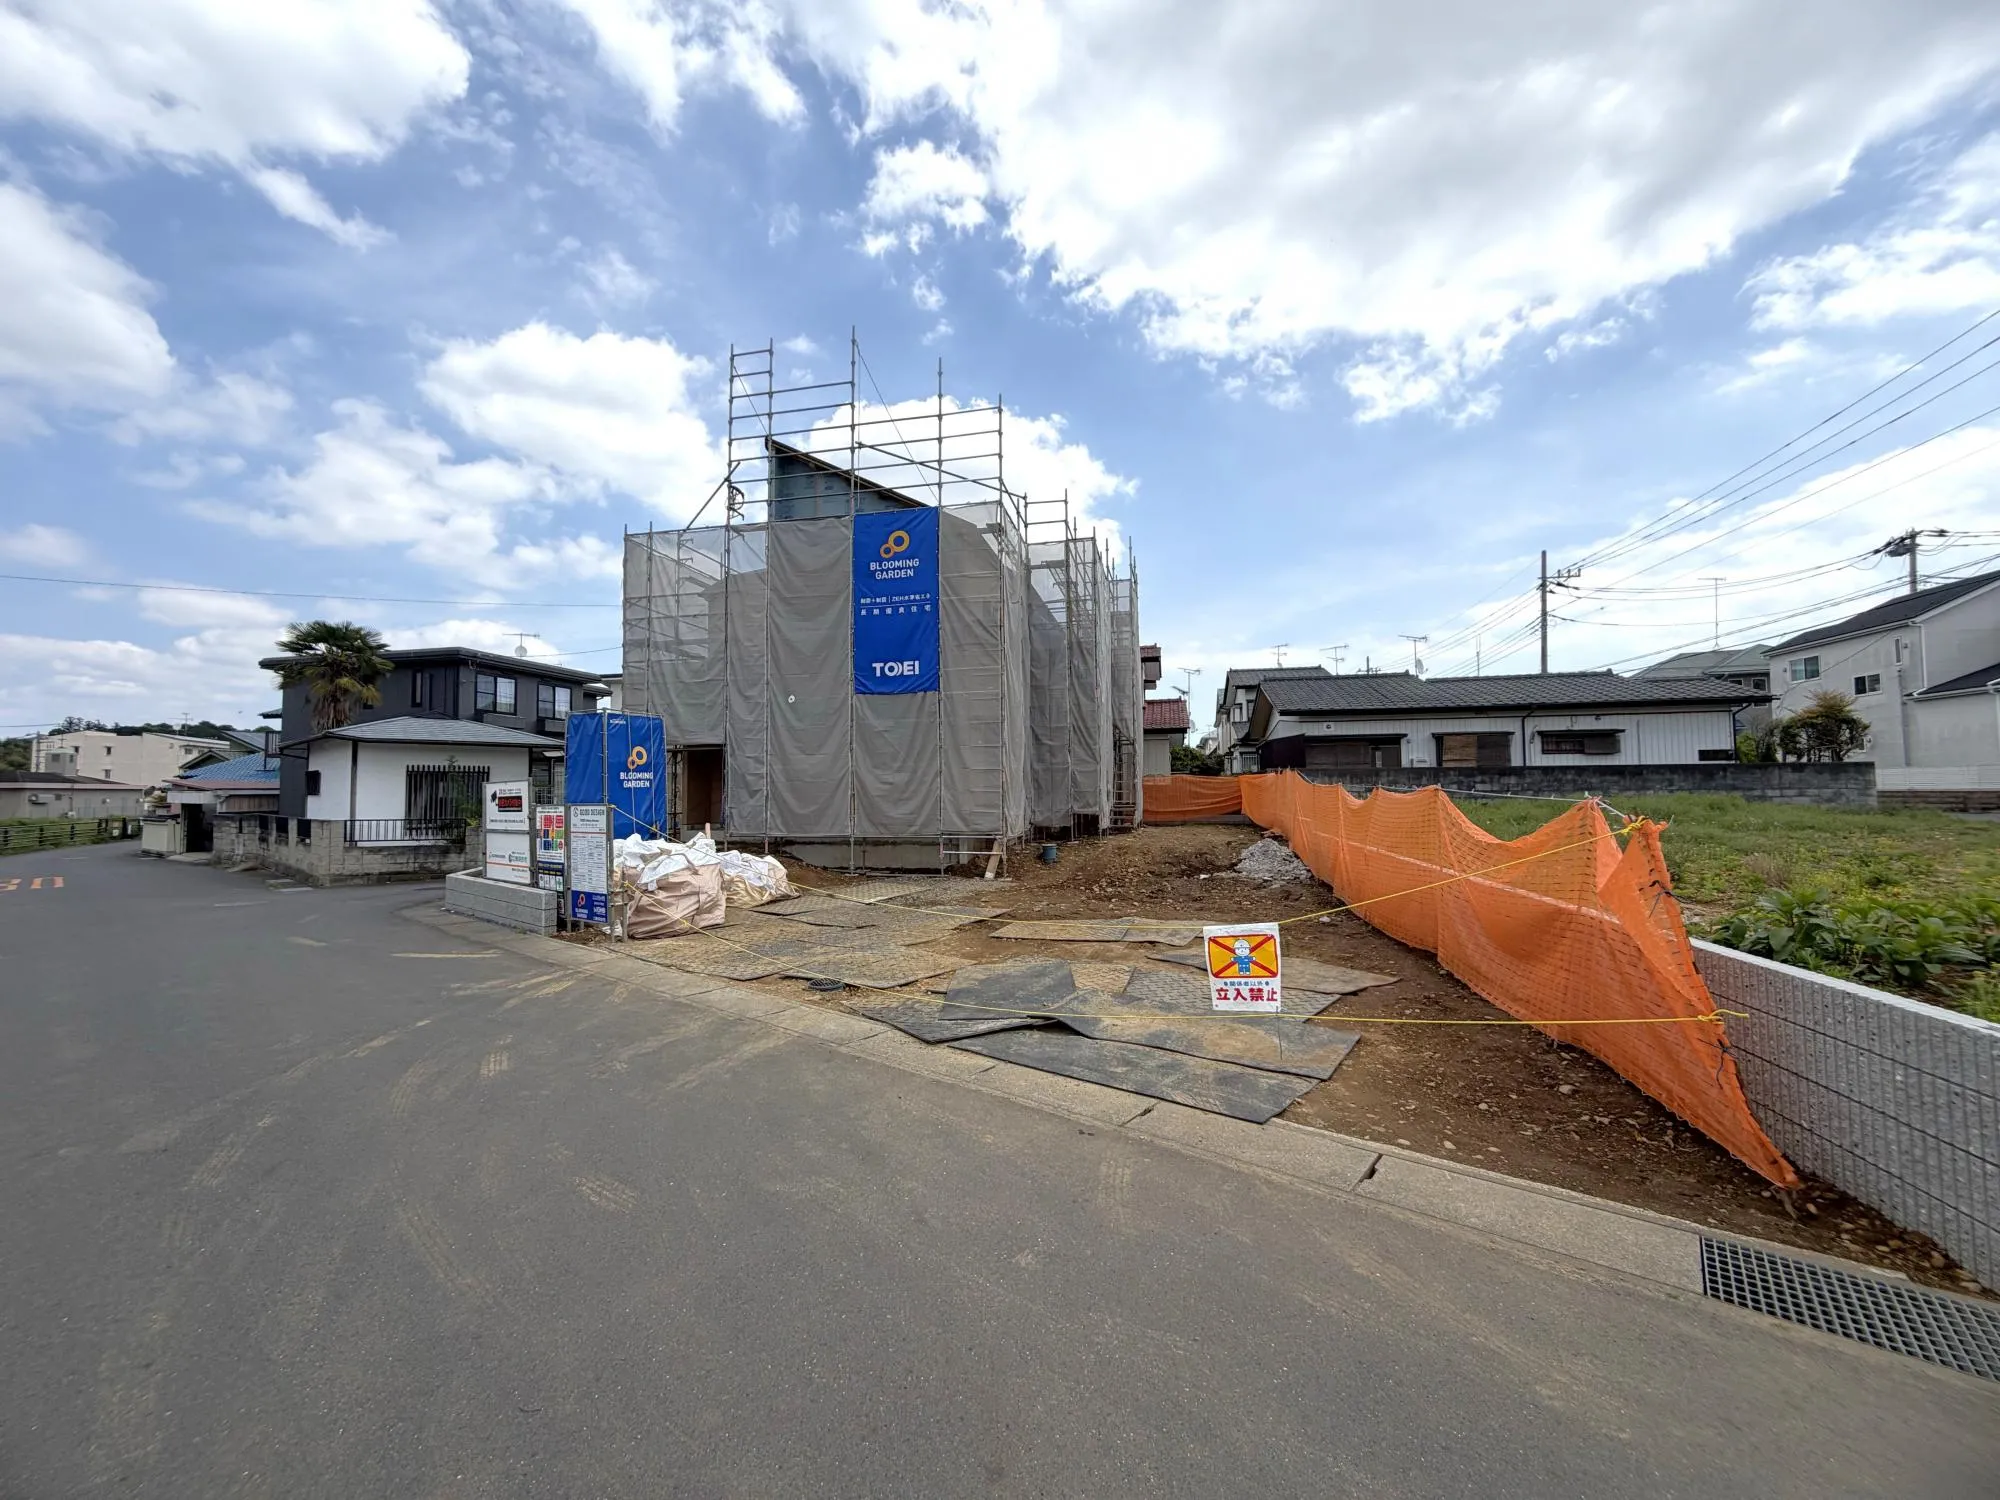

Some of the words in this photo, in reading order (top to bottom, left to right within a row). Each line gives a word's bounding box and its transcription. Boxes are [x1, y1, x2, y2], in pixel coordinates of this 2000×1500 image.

[870, 558, 919, 571] BLOOMING
[875, 568, 914, 580] GARDEN
[872, 660, 919, 677] TOEI
[619, 771, 653, 780] BLOOMING
[623, 780, 650, 788] GARDEN
[1215, 987, 1278, 1001] 立入禁止
